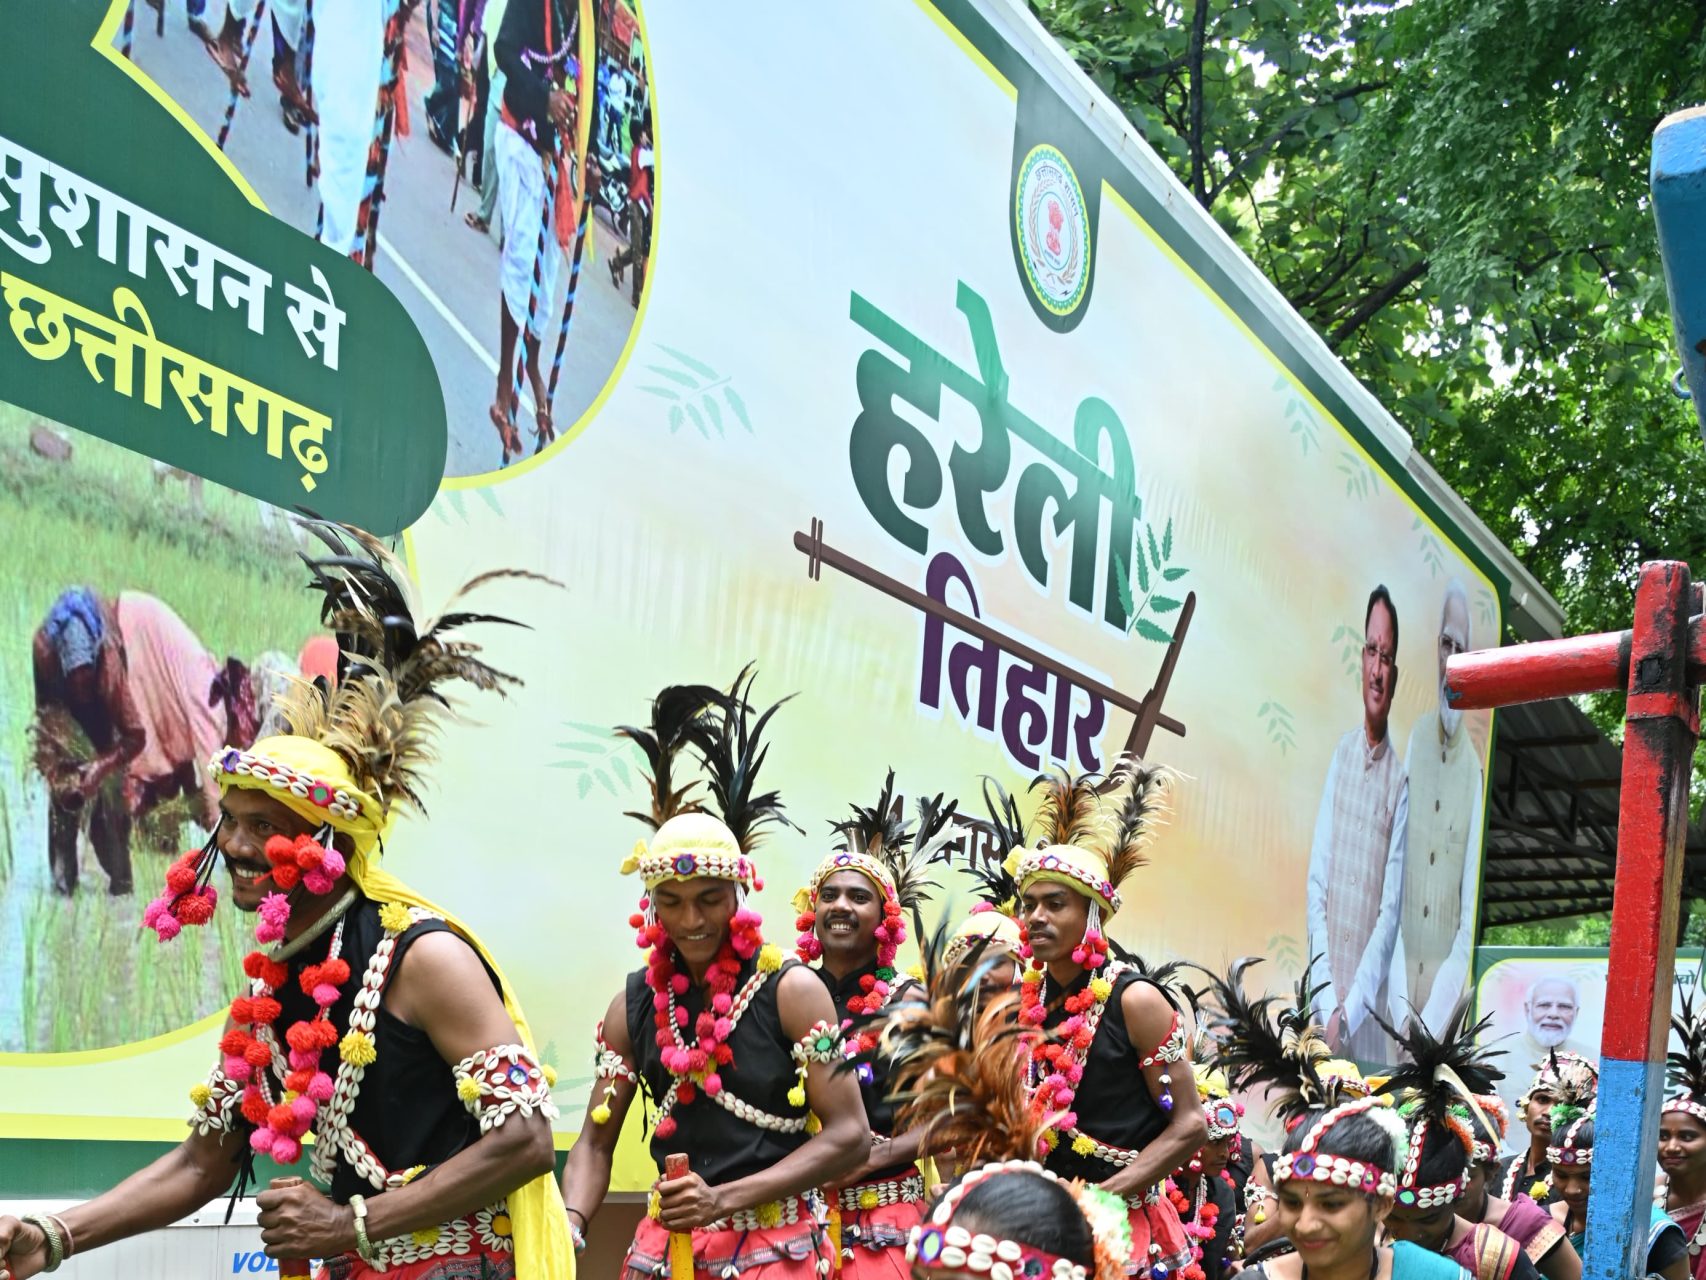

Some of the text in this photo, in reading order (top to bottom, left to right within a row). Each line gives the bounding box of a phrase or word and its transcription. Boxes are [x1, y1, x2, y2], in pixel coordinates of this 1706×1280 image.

[0, 135, 347, 371] सुशासन से
[0, 271, 333, 493] छत्तीसगढ़
[849, 279, 1142, 633] हरेली
[919, 551, 1106, 773] तिहार
